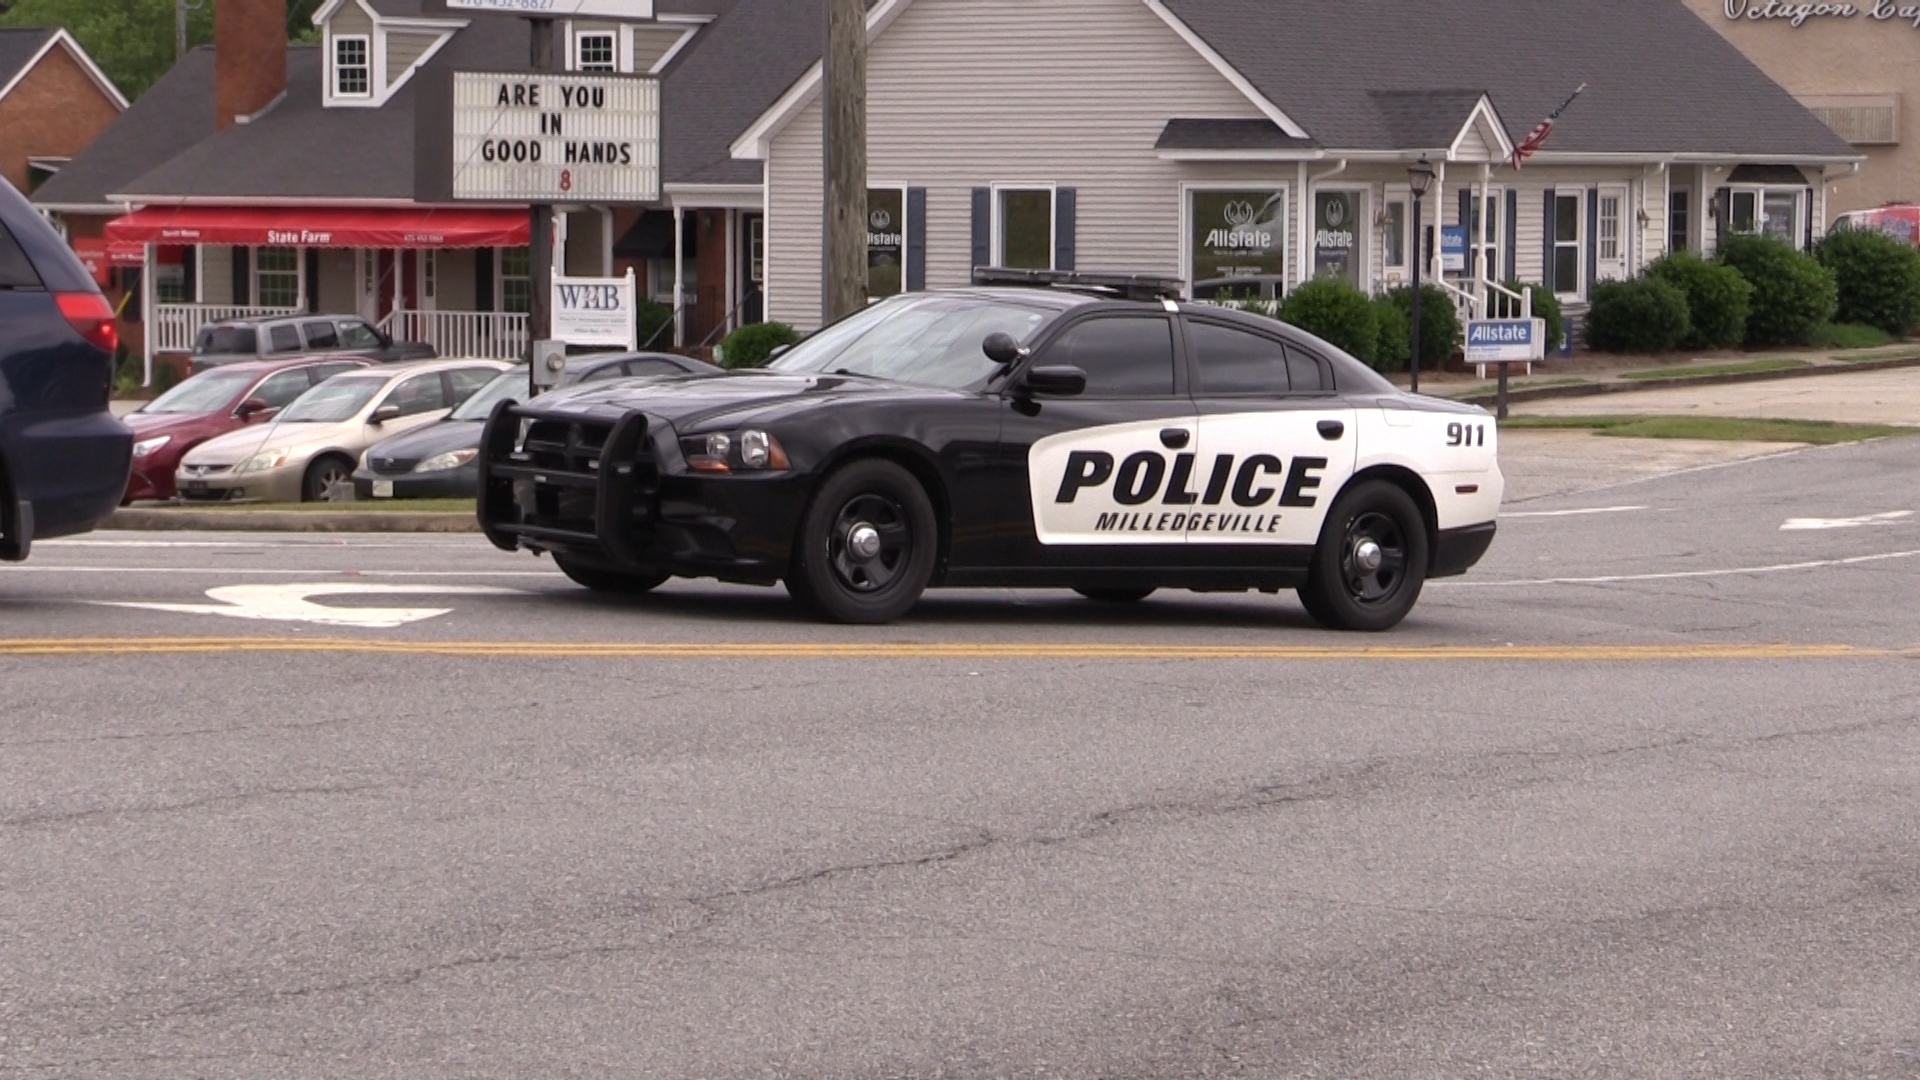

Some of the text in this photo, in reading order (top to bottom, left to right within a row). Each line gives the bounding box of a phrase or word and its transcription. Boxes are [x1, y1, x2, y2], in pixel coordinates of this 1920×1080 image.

[1724, 0, 1858, 28] Octagon
[498, 83, 604, 108] ARE YOU
[541, 112, 562, 135] IN
[482, 139, 631, 164] GOOD HANDS
[560, 168, 571, 191] 8
[267, 229, 331, 243] State Farm
[867, 231, 901, 246] llstate
[1203, 228, 1271, 248] Allstate
[1314, 229, 1353, 248] Allstate
[1470, 324, 1527, 342] Allstate
[1446, 421, 1484, 447] 911
[1055, 450, 1327, 508] POLICE
[1095, 512, 1282, 533] MILLEDGEVILLE
